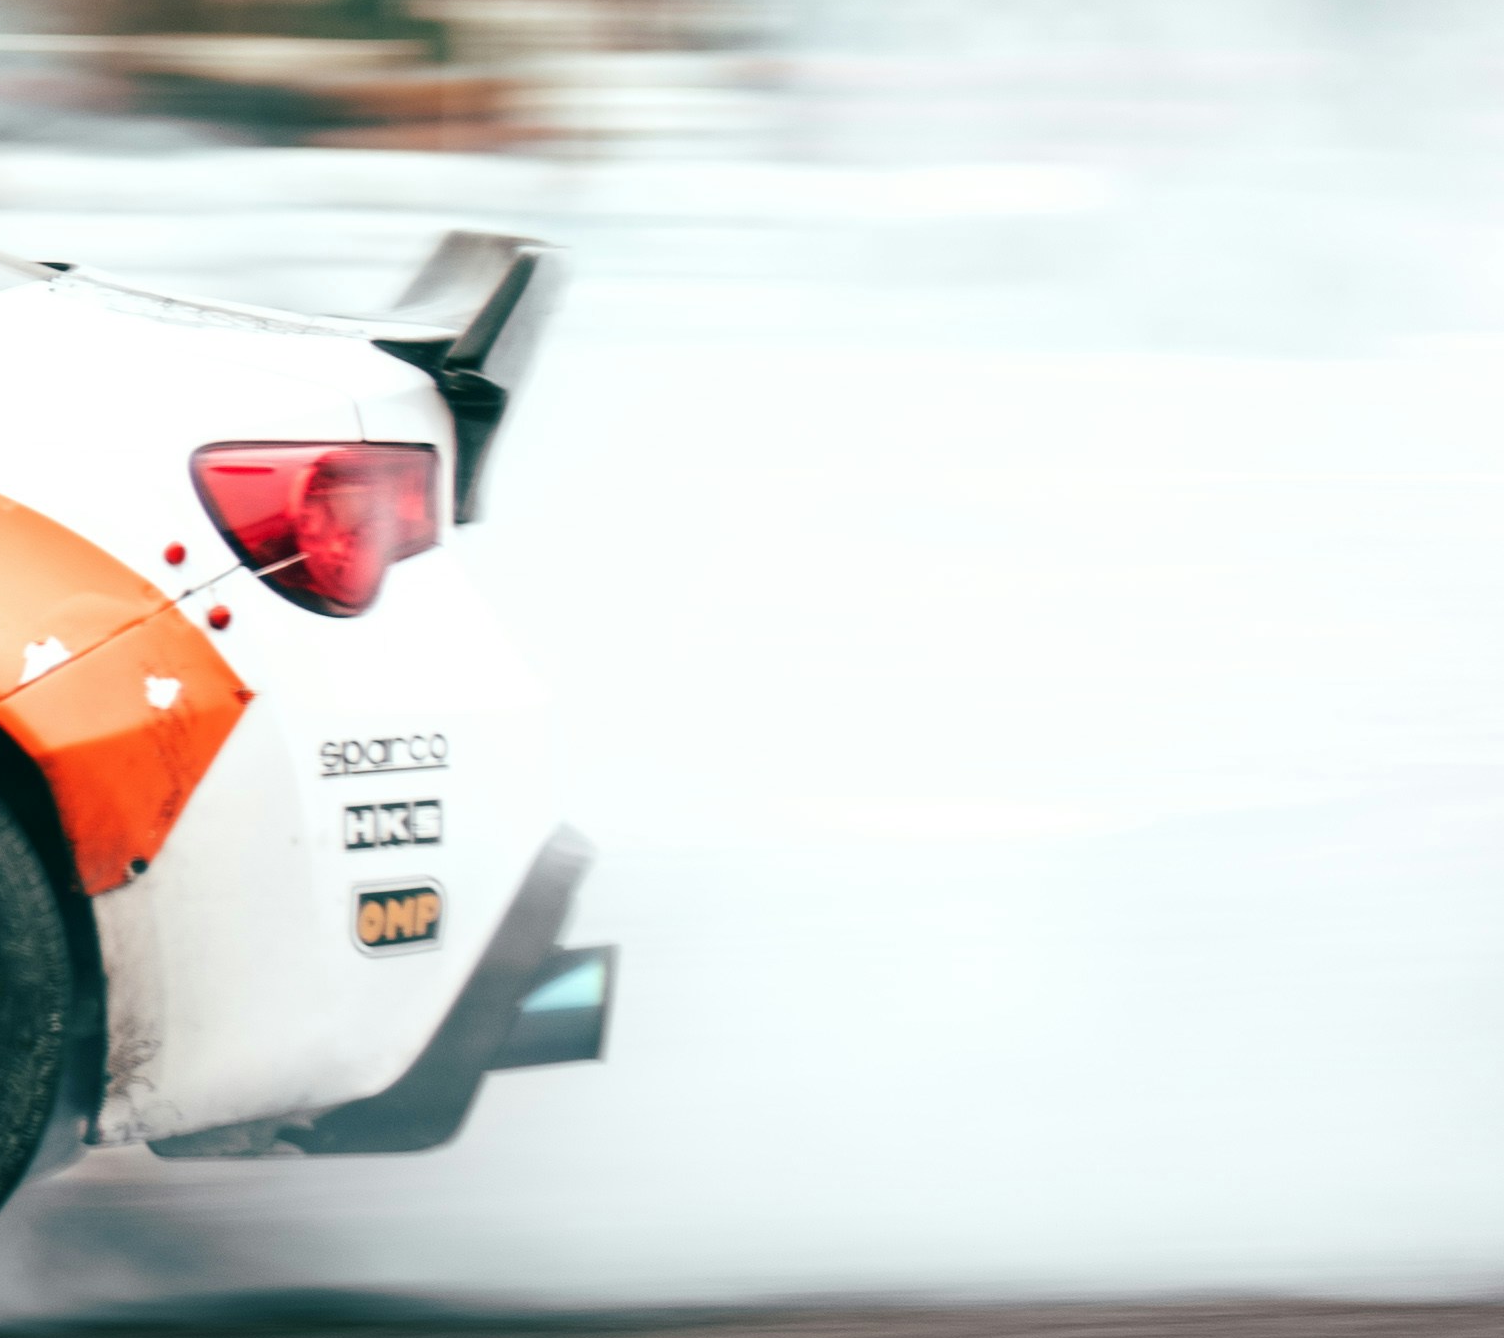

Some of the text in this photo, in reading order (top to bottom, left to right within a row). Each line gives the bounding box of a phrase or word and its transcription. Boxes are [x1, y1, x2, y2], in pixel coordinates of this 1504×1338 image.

[320, 734, 448, 774] sparco
[345, 800, 441, 849] HKS
[358, 893, 438, 944] OMP
